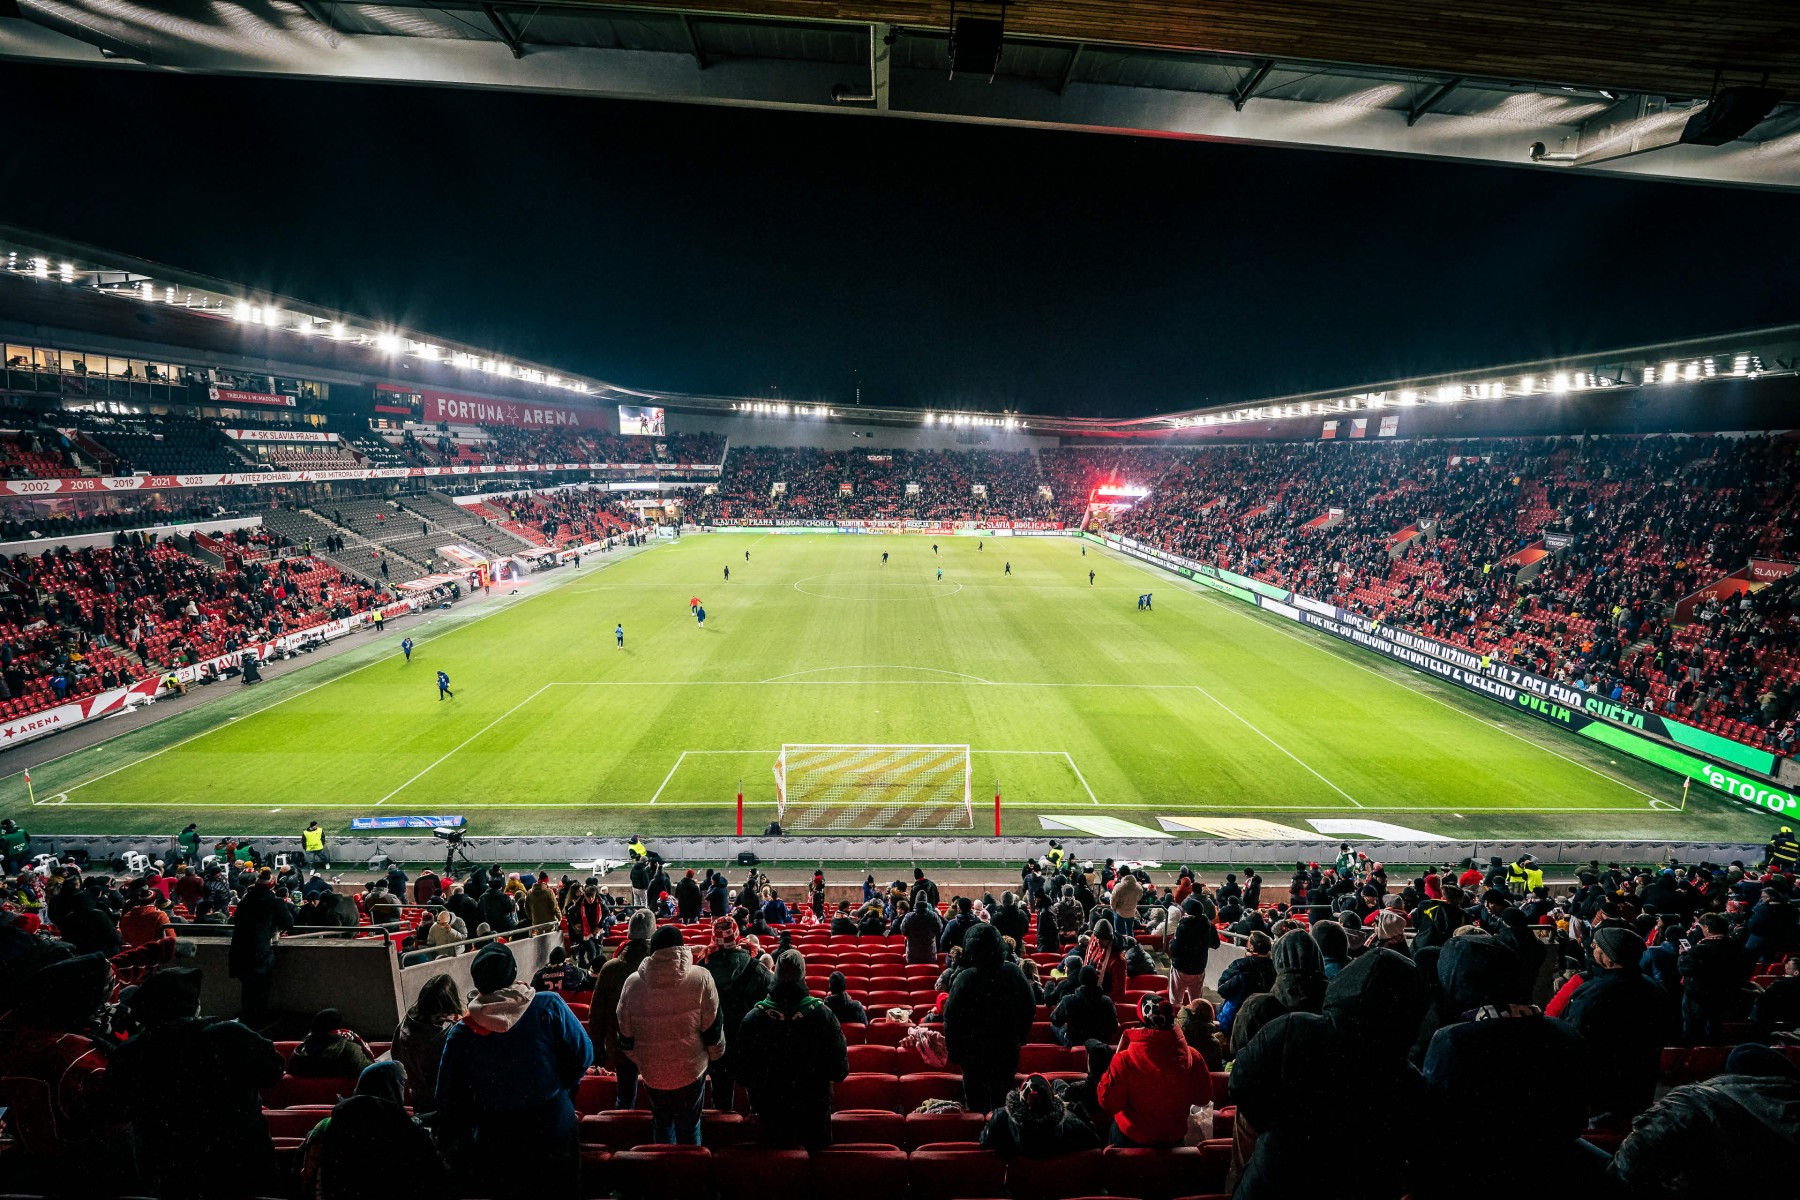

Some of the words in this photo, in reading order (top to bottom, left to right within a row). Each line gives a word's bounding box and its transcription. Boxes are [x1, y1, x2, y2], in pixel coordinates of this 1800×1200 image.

[226, 392, 247, 400] TRIBUNA
[437, 398, 504, 422] FORTUNA
[523, 408, 579, 426] ARENA
[269, 432, 295, 440] SLAVIA
[21, 482, 50, 492] 2002
[71, 480, 95, 490] 2018
[113, 479, 134, 488] 2019
[151, 478, 170, 487] 2021
[185, 477, 204, 485] 2023
[987, 521, 1010, 529] SLAVIA
[1014, 521, 1058, 529] HOOLIGANS
[1754, 567, 1788, 577] SLAVIA
[1705, 590, 1718, 598] 117
[200, 654, 242, 677] SAVI
[180, 670, 190, 680] 25
[1585, 697, 1644, 730] SVĚTA
[20, 715, 60, 734] ARENA
